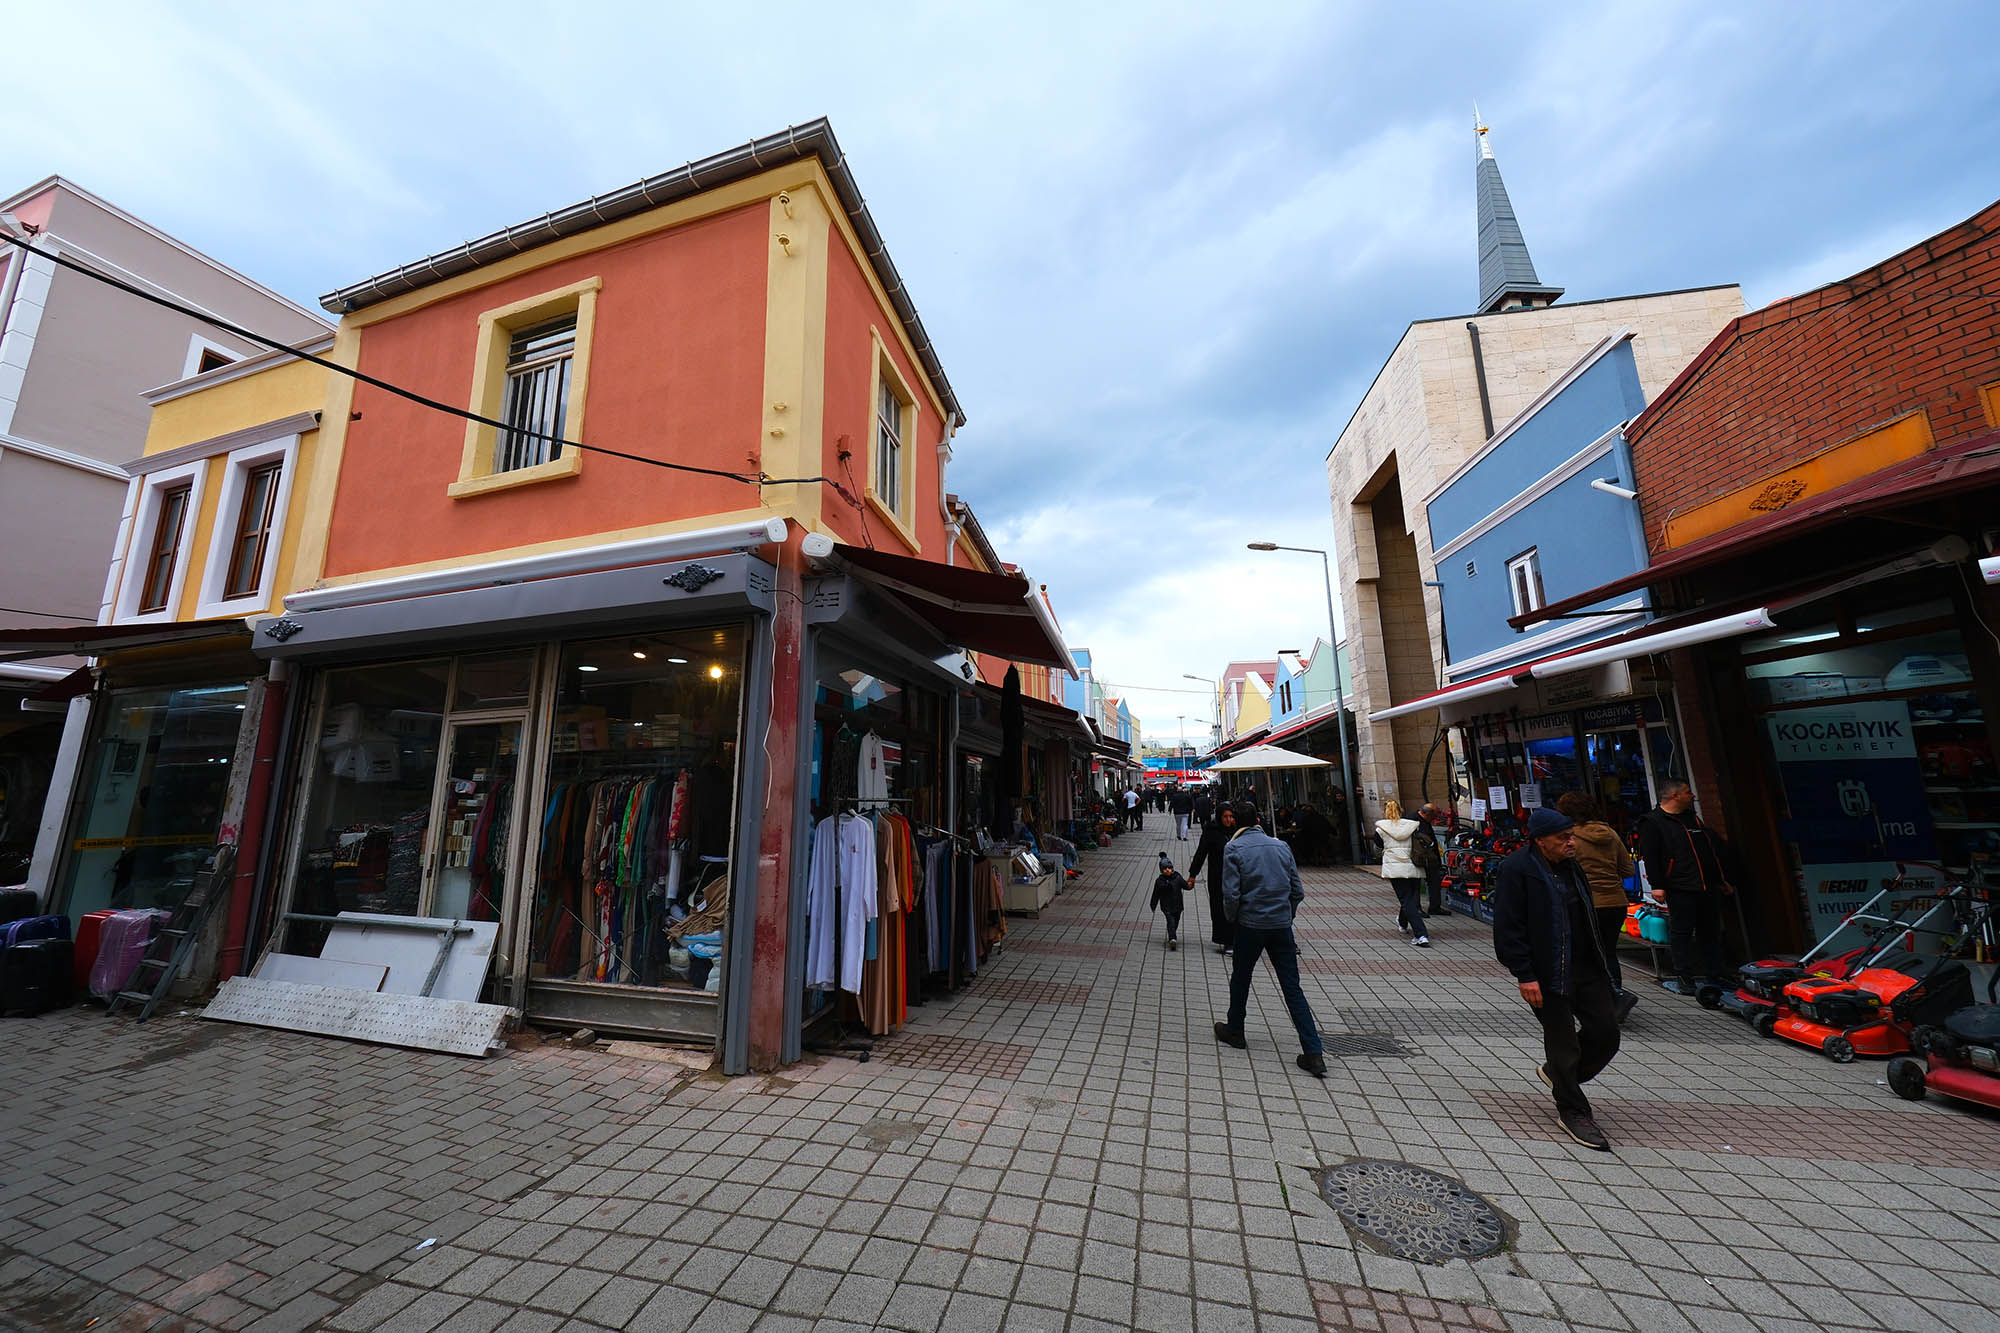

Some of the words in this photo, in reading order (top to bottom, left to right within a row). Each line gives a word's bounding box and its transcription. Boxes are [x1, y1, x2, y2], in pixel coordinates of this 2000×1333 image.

[1776, 720, 1904, 741] KOCABIYIK
[1828, 880, 1869, 894] ECHO
[1384, 1195, 1438, 1214] ADASU
